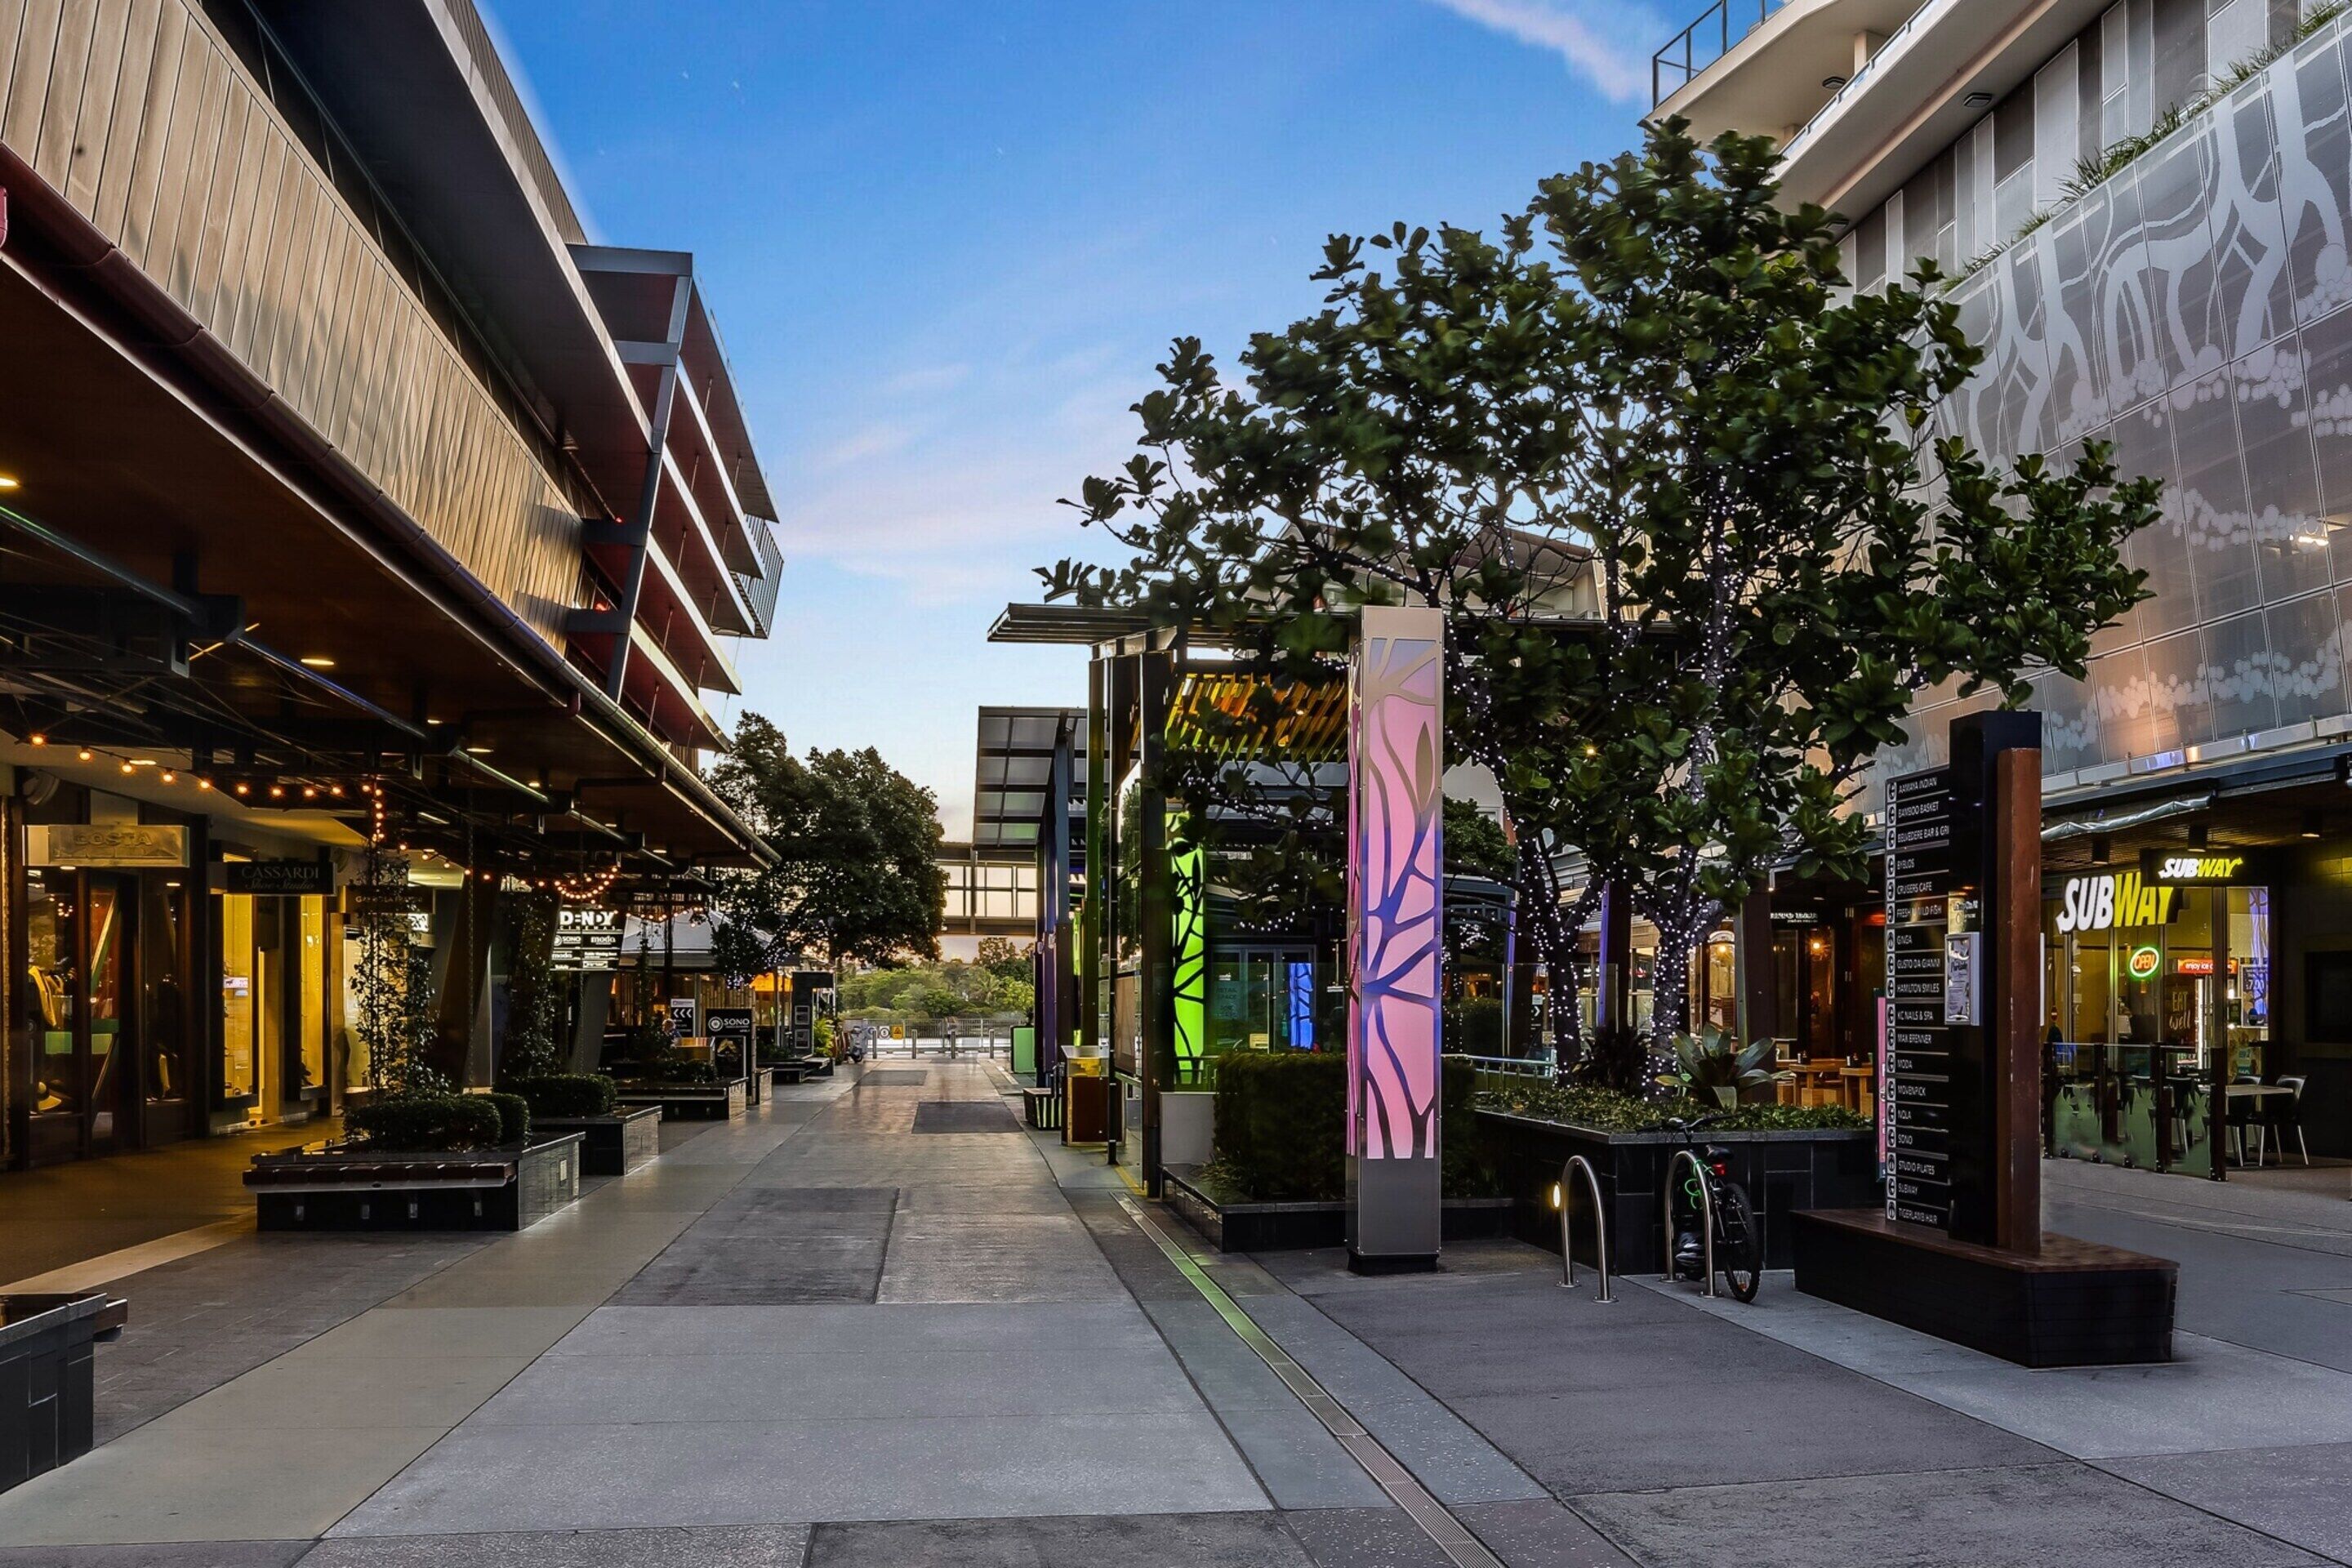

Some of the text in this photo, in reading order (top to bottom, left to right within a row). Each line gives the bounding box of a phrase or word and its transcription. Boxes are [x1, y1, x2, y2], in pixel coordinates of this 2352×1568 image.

[1919, 777, 1937, 789] INDIAN
[1898, 801, 1939, 818] BAMBOO BASKET
[75, 831, 153, 847] COSTA
[1897, 830, 1923, 843] BELVEDERE
[1924, 827, 1935, 839] BAR
[242, 866, 318, 879] CASSARDI
[2158, 858, 2243, 879] SUBWAY
[245, 878, 314, 889] Shoe Studio
[1918, 881, 1932, 893] CAFE
[2056, 871, 2173, 934] SUBWAY
[1896, 908, 1911, 918] FRESH
[1930, 904, 1942, 915] FISH
[559, 911, 615, 925] DENDY
[1896, 959, 1913, 969] GUSTO
[1913, 959, 1921, 969] DA
[2134, 953, 2155, 969] OPEN
[2185, 962, 2200, 970] enjoy
[1896, 982, 1940, 994] HAMILTON SMILES
[2172, 991, 2189, 1012] EAT
[1904, 1011, 1918, 1020] NAILS
[1919, 1011, 1923, 1021] &
[1923, 1011, 1934, 1021] SPA
[2169, 1009, 2191, 1031] well
[1909, 1033, 1931, 1044] BRENNER
[1897, 1059, 1913, 1069] MODA
[1897, 1110, 1912, 1120] NOLA
[1897, 1134, 1913, 1145] SONO
[1898, 1160, 1916, 1172] STUDIO
[1898, 1183, 1918, 1196] SUBWAY
[1925, 1214, 1937, 1224] HAIR
